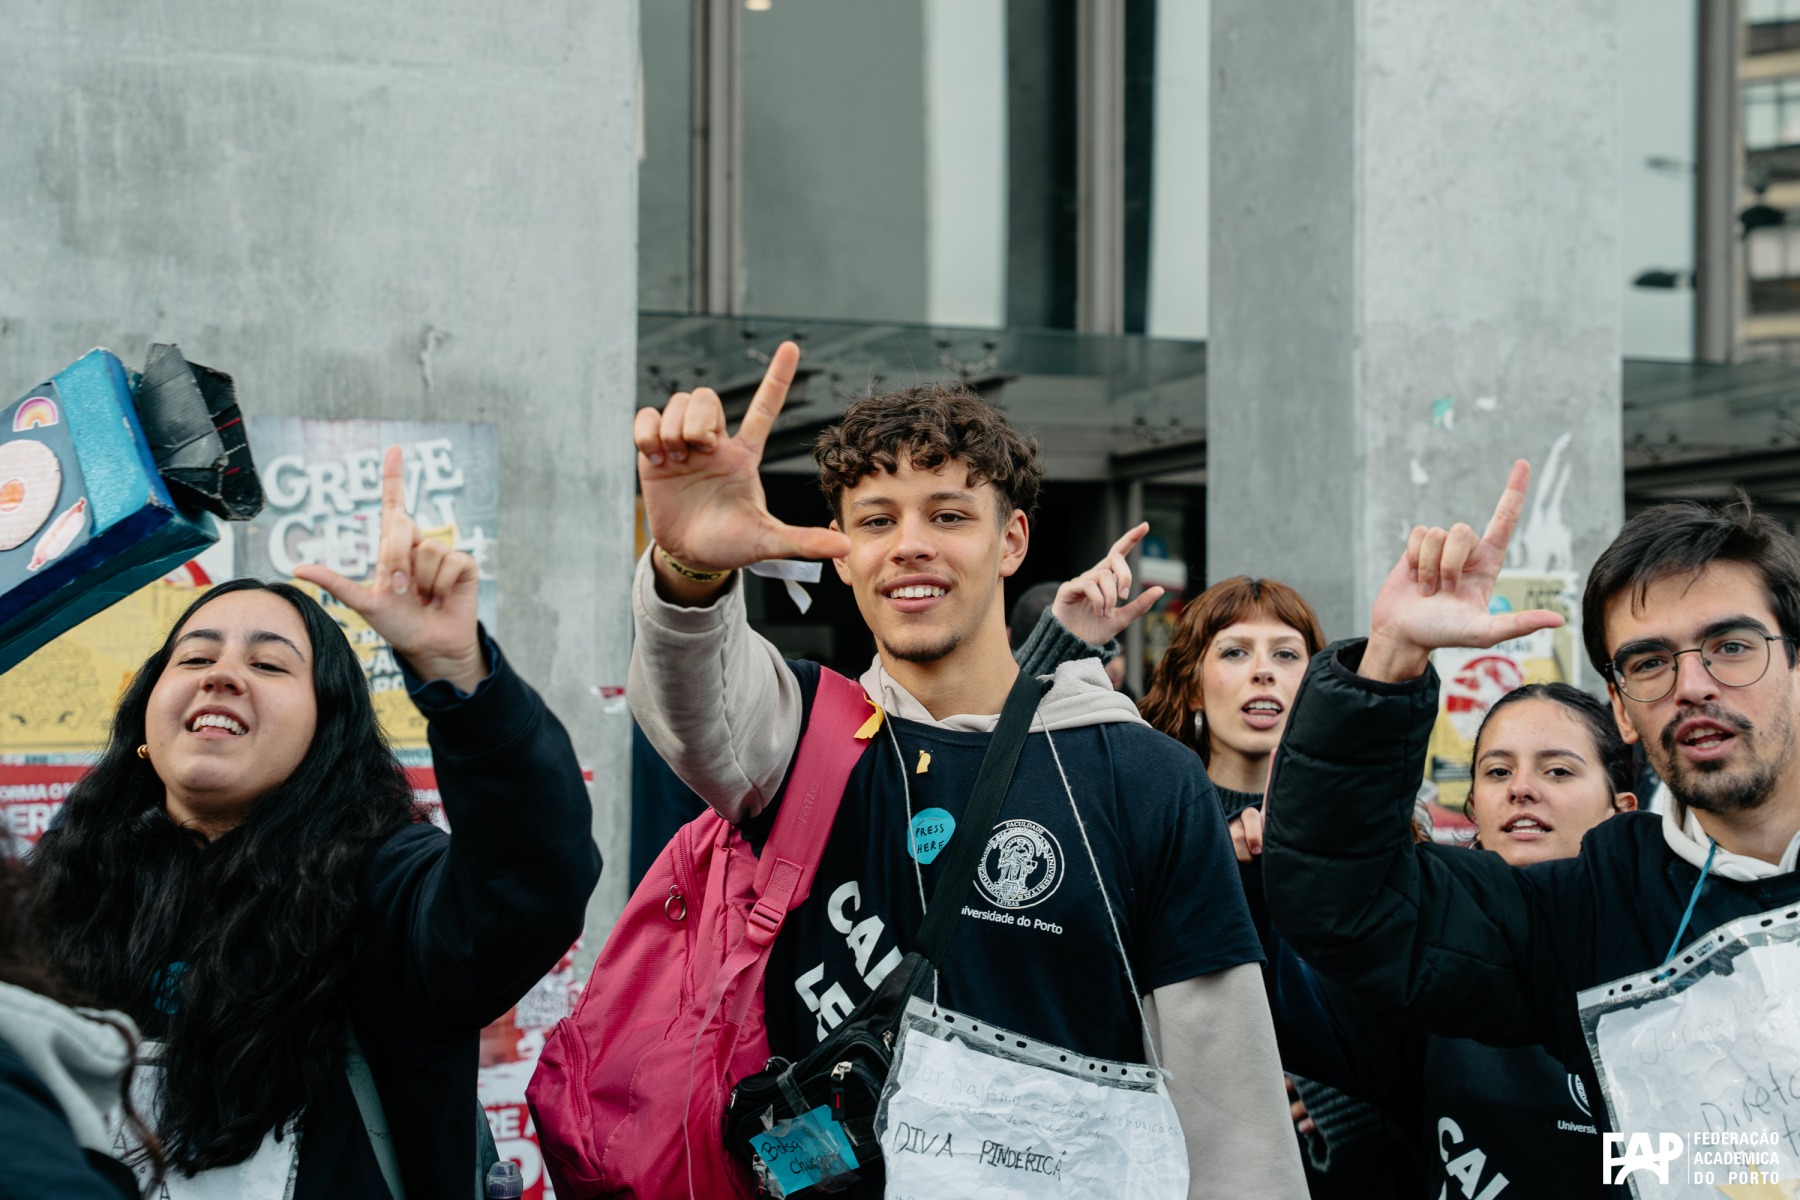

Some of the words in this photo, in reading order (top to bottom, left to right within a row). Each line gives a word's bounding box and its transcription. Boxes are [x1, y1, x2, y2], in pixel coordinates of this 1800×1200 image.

[915, 823, 945, 838] PRESS
[1005, 821, 1046, 835] FACULDADE
[916, 839, 946, 854] HERE
[996, 898, 1020, 907] LETRAS
[1017, 914, 1032, 927] do
[1033, 918, 1063, 935] Porto
[893, 1121, 954, 1159] DIVA
